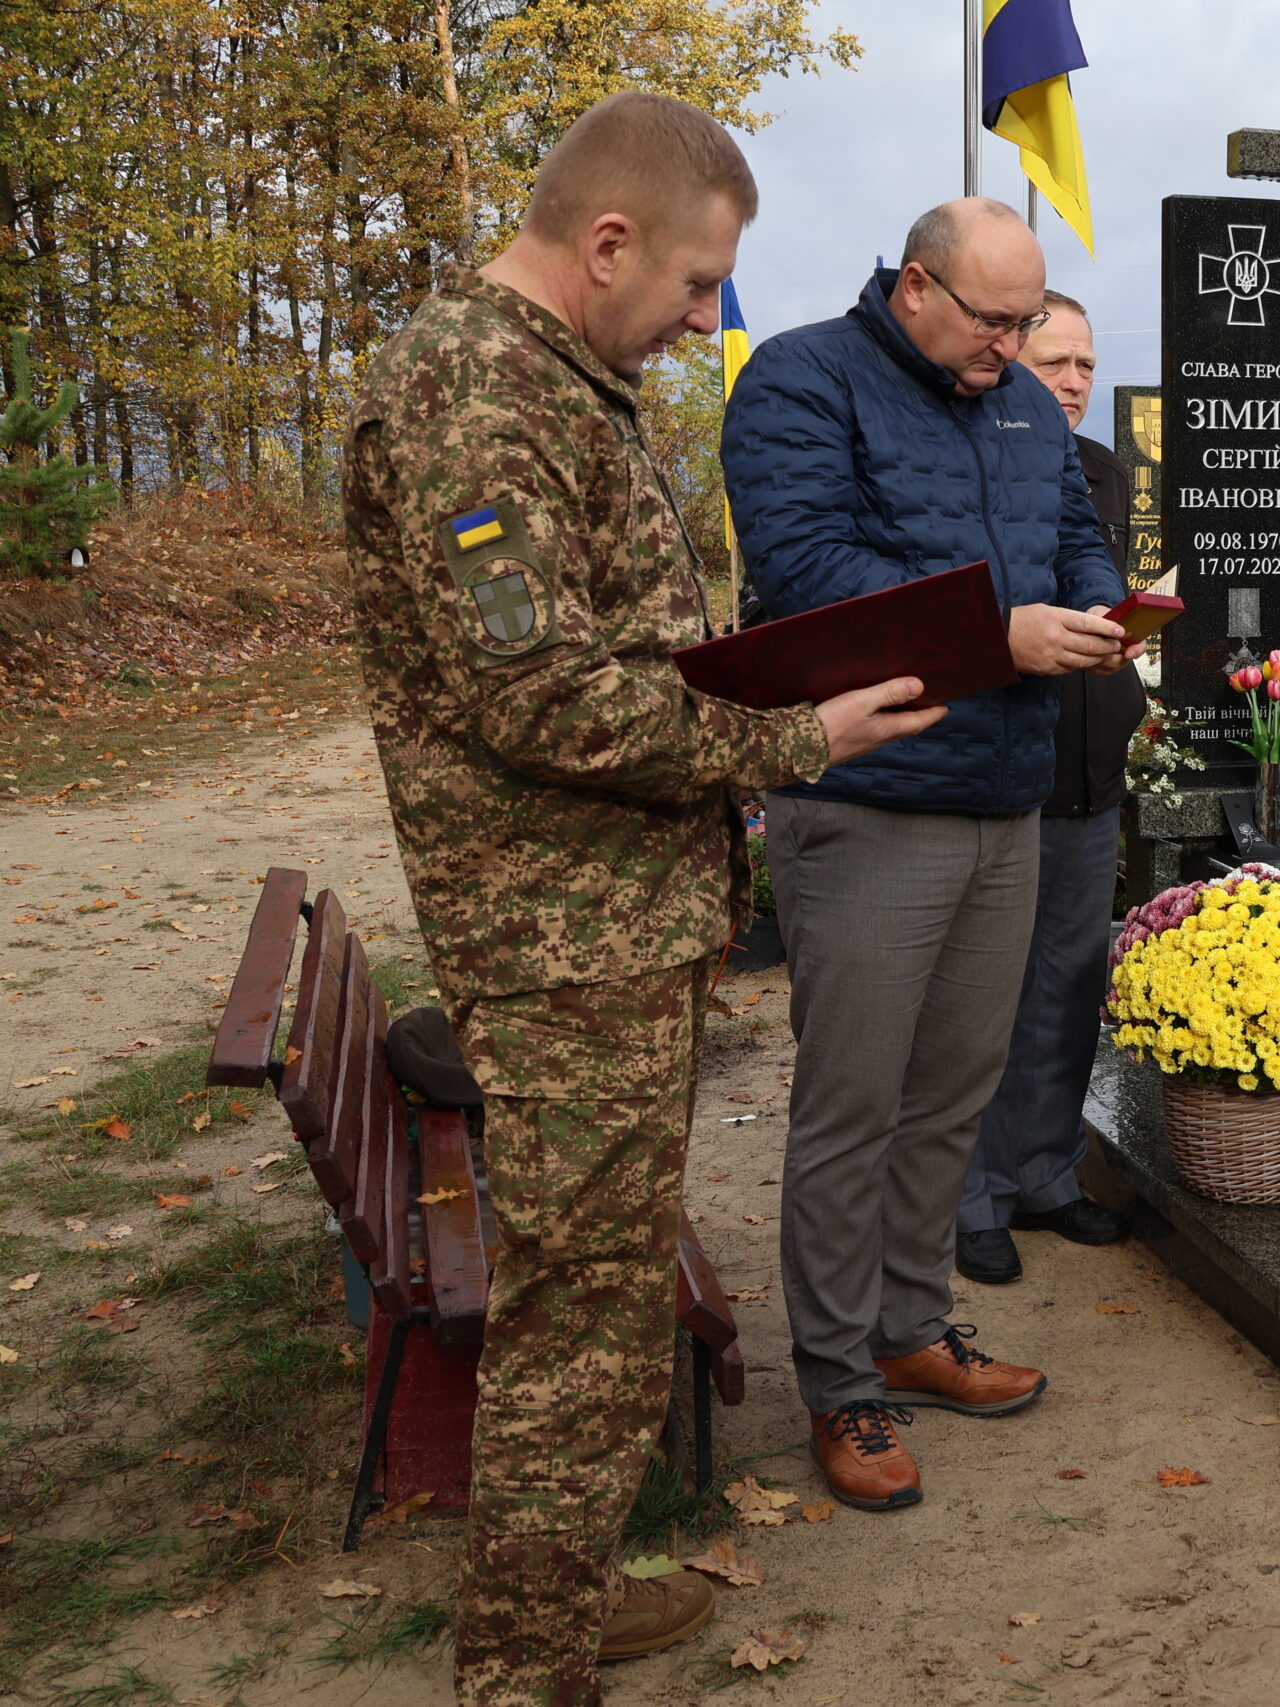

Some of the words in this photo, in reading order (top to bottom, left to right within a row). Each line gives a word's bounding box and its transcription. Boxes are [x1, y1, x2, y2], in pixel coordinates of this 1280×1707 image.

[1181, 362, 1241, 377] СЛАВА
[996, 419, 1030, 430] Columbia
[1127, 572, 1158, 590] Йос
[1184, 706, 1216, 720] Твій
[1220, 705, 1268, 719] вічнй
[1190, 728, 1219, 740] наш
